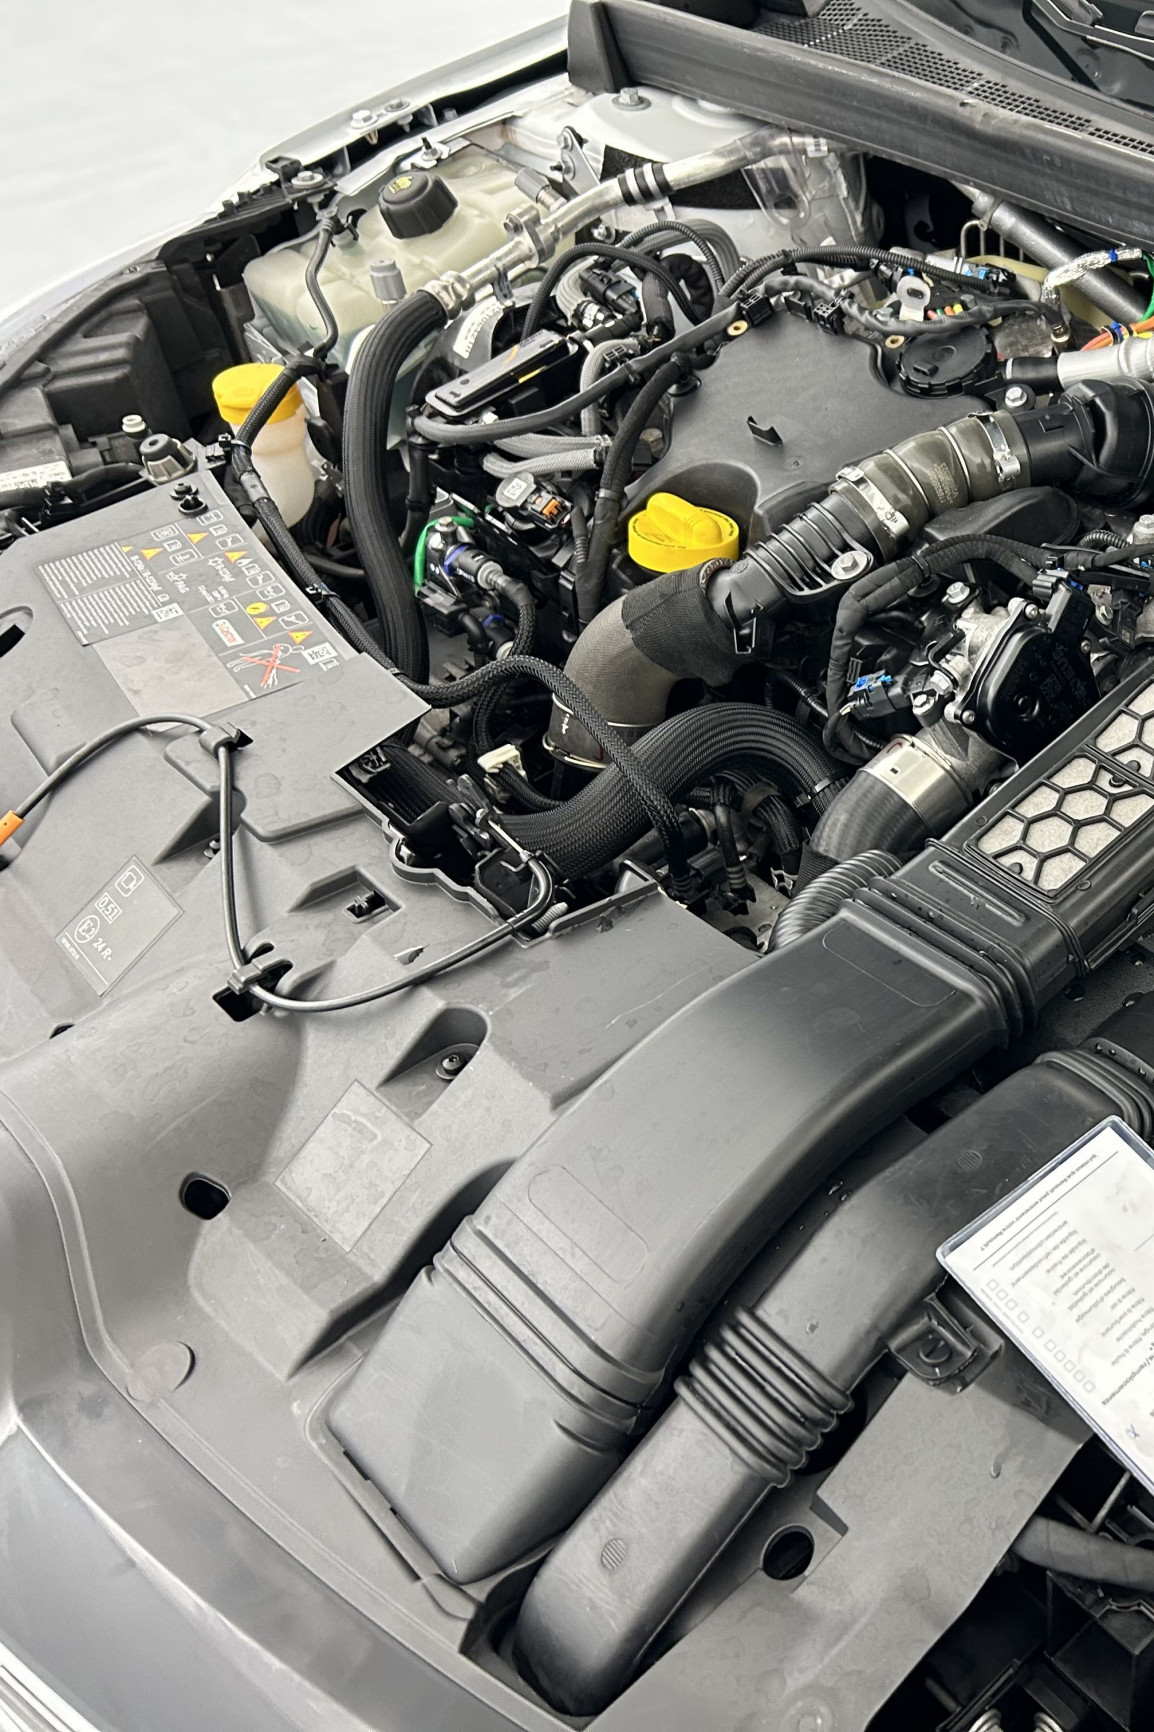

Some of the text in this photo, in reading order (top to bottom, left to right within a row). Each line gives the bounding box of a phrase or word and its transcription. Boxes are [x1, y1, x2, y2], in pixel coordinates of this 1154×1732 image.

[1065, 1169, 1077, 1180] que
[1074, 1158, 1091, 1173] mieux
[1036, 1190, 1051, 1203] peut
[1048, 1176, 1068, 1195] Renault
[1013, 1199, 1040, 1222] entretenir
[1000, 1219, 1016, 1233] votre
[1042, 1218, 1069, 1242] entretien
[982, 1229, 1003, 1248] Renault
[1007, 1238, 1046, 1272] climatisation
[1009, 1227, 1078, 1288] liquide de refroidissement
[1044, 1236, 1087, 1275] liquide de freins
[1101, 1261, 1111, 1271] de
[1073, 1275, 1126, 1324] bougies d'allumage
[1099, 1310, 1129, 1338] carburant
[1114, 1316, 1143, 1343] habitacle
[1109, 1351, 1126, 1367] huile
[1100, 1360, 1148, 1407] remplacements
